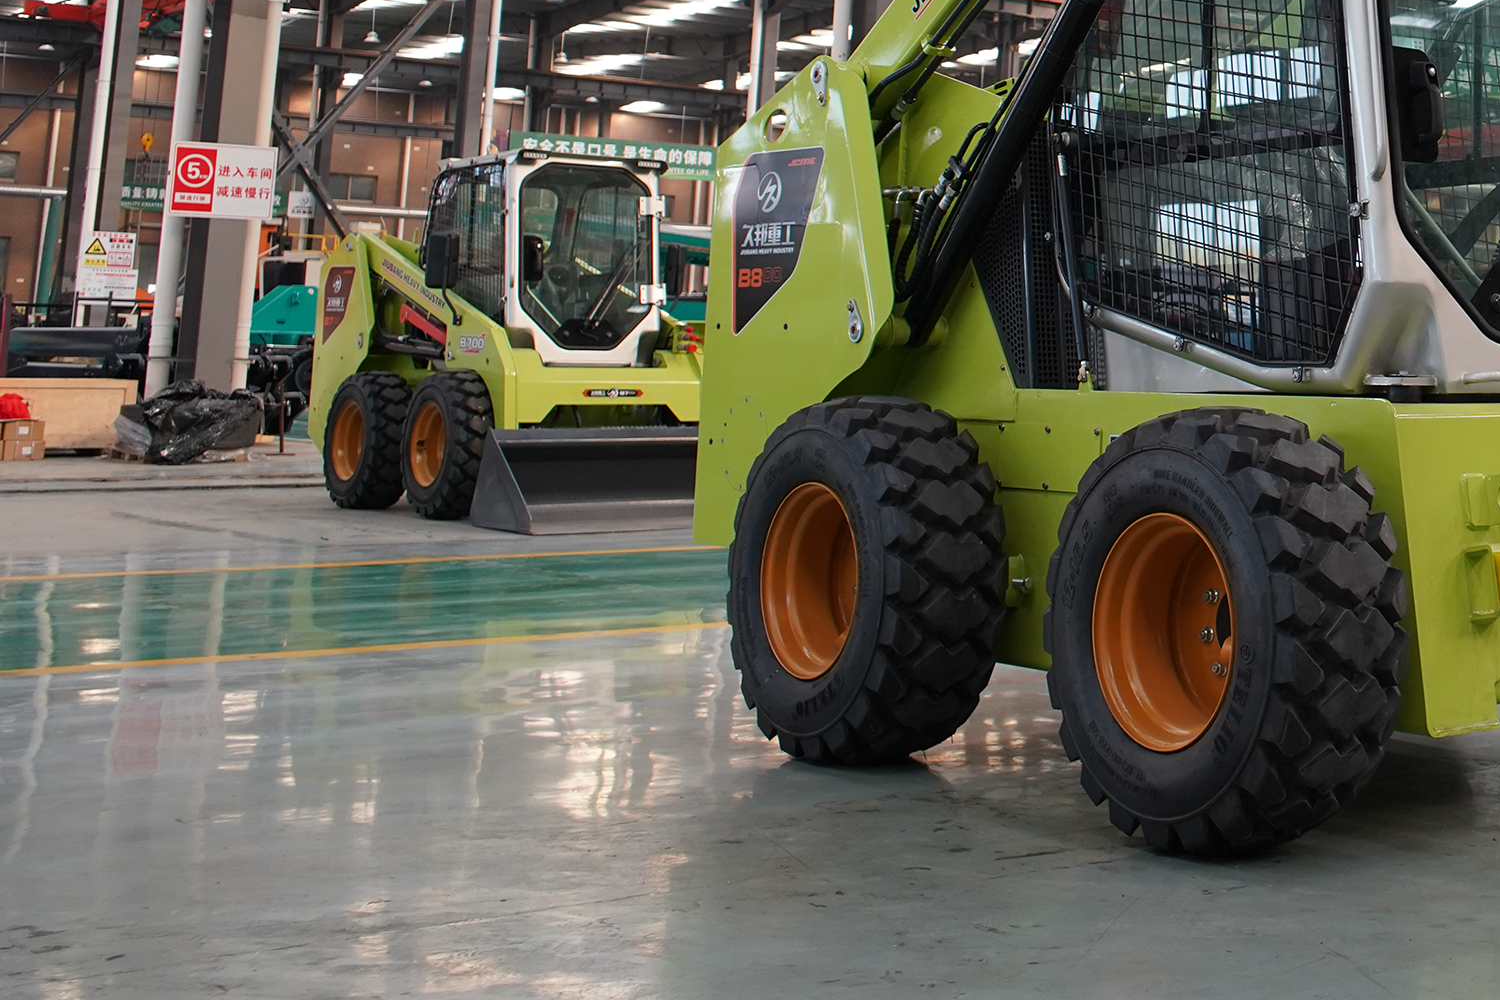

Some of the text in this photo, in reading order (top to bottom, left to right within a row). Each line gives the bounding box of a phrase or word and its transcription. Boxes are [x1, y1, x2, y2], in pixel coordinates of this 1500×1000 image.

[623, 144, 713, 166] 是生命的保障
[187, 161, 201, 180] 5
[218, 165, 273, 180] 进入车间
[216, 185, 271, 200] 减速慢行
[740, 221, 796, 248] 久邦重工
[382, 258, 446, 309] JIUBANG HEAVY INDUSTRY
[737, 266, 782, 288] B800
[459, 335, 485, 349] B700
